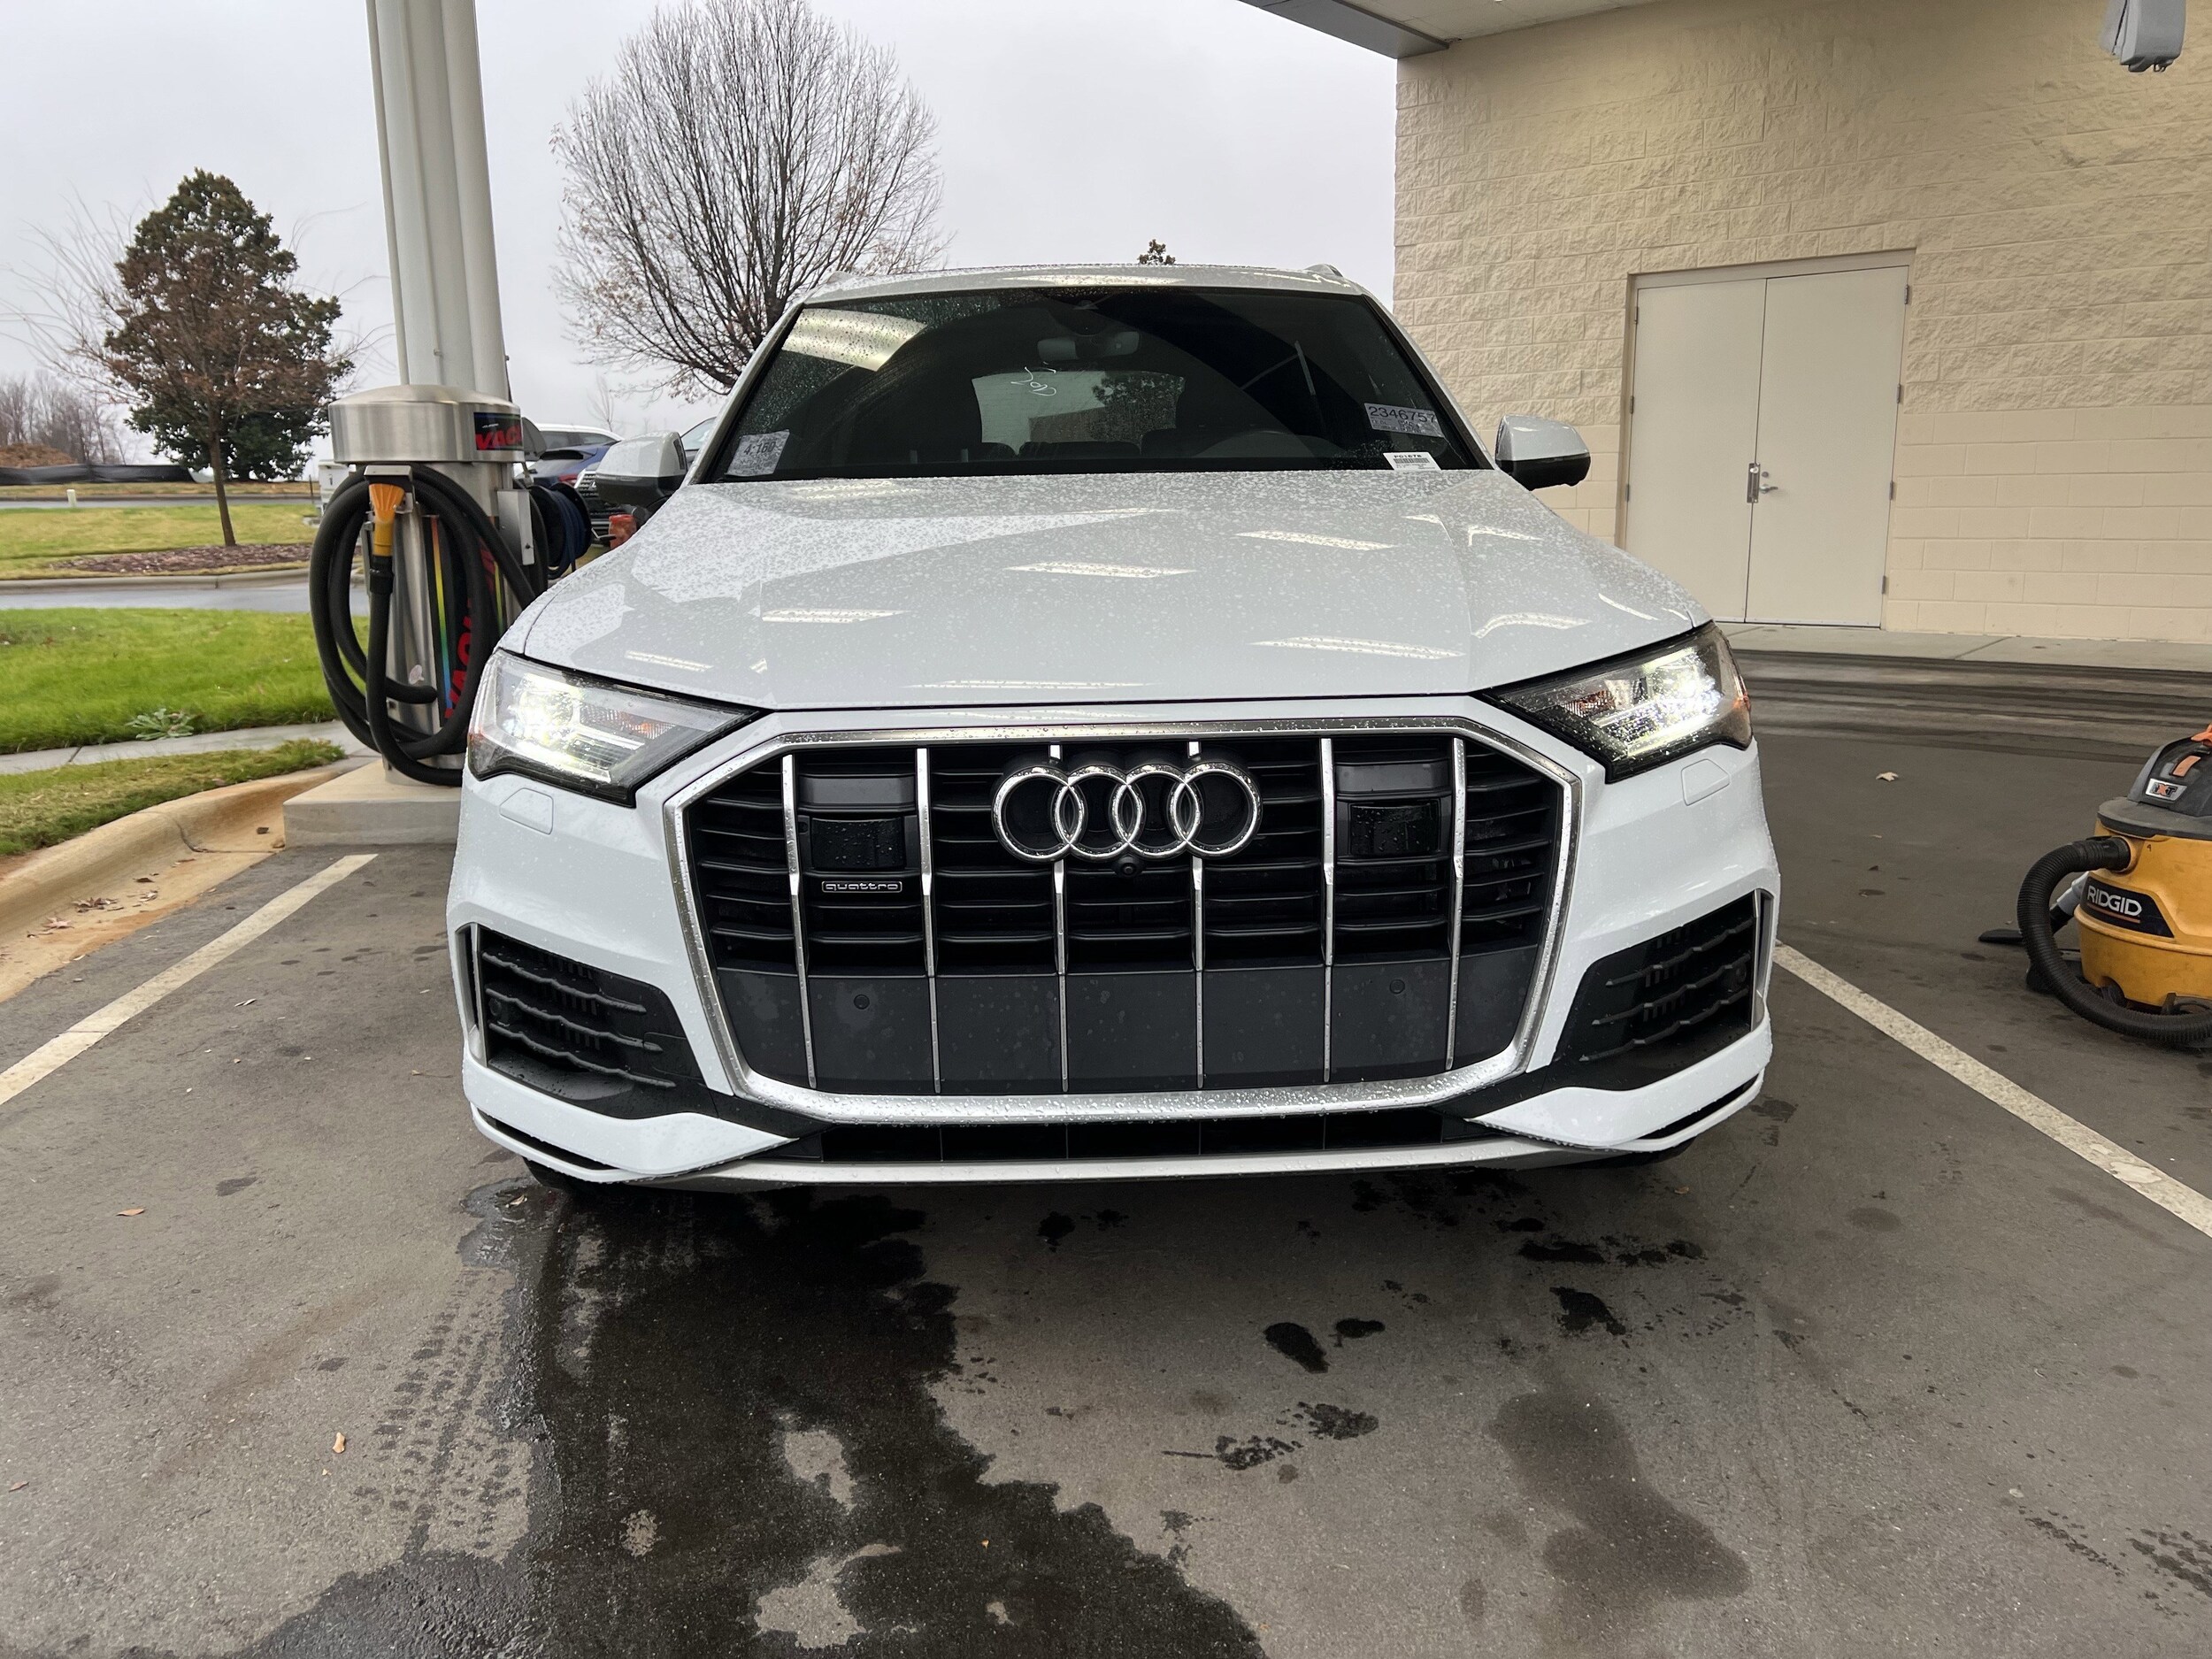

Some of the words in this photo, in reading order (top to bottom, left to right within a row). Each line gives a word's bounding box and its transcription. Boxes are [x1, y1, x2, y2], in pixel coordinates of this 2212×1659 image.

[1368, 406, 1435, 423] 2346757
[826, 882, 898, 892] quattro
[2087, 886, 2142, 917] RIDGID
